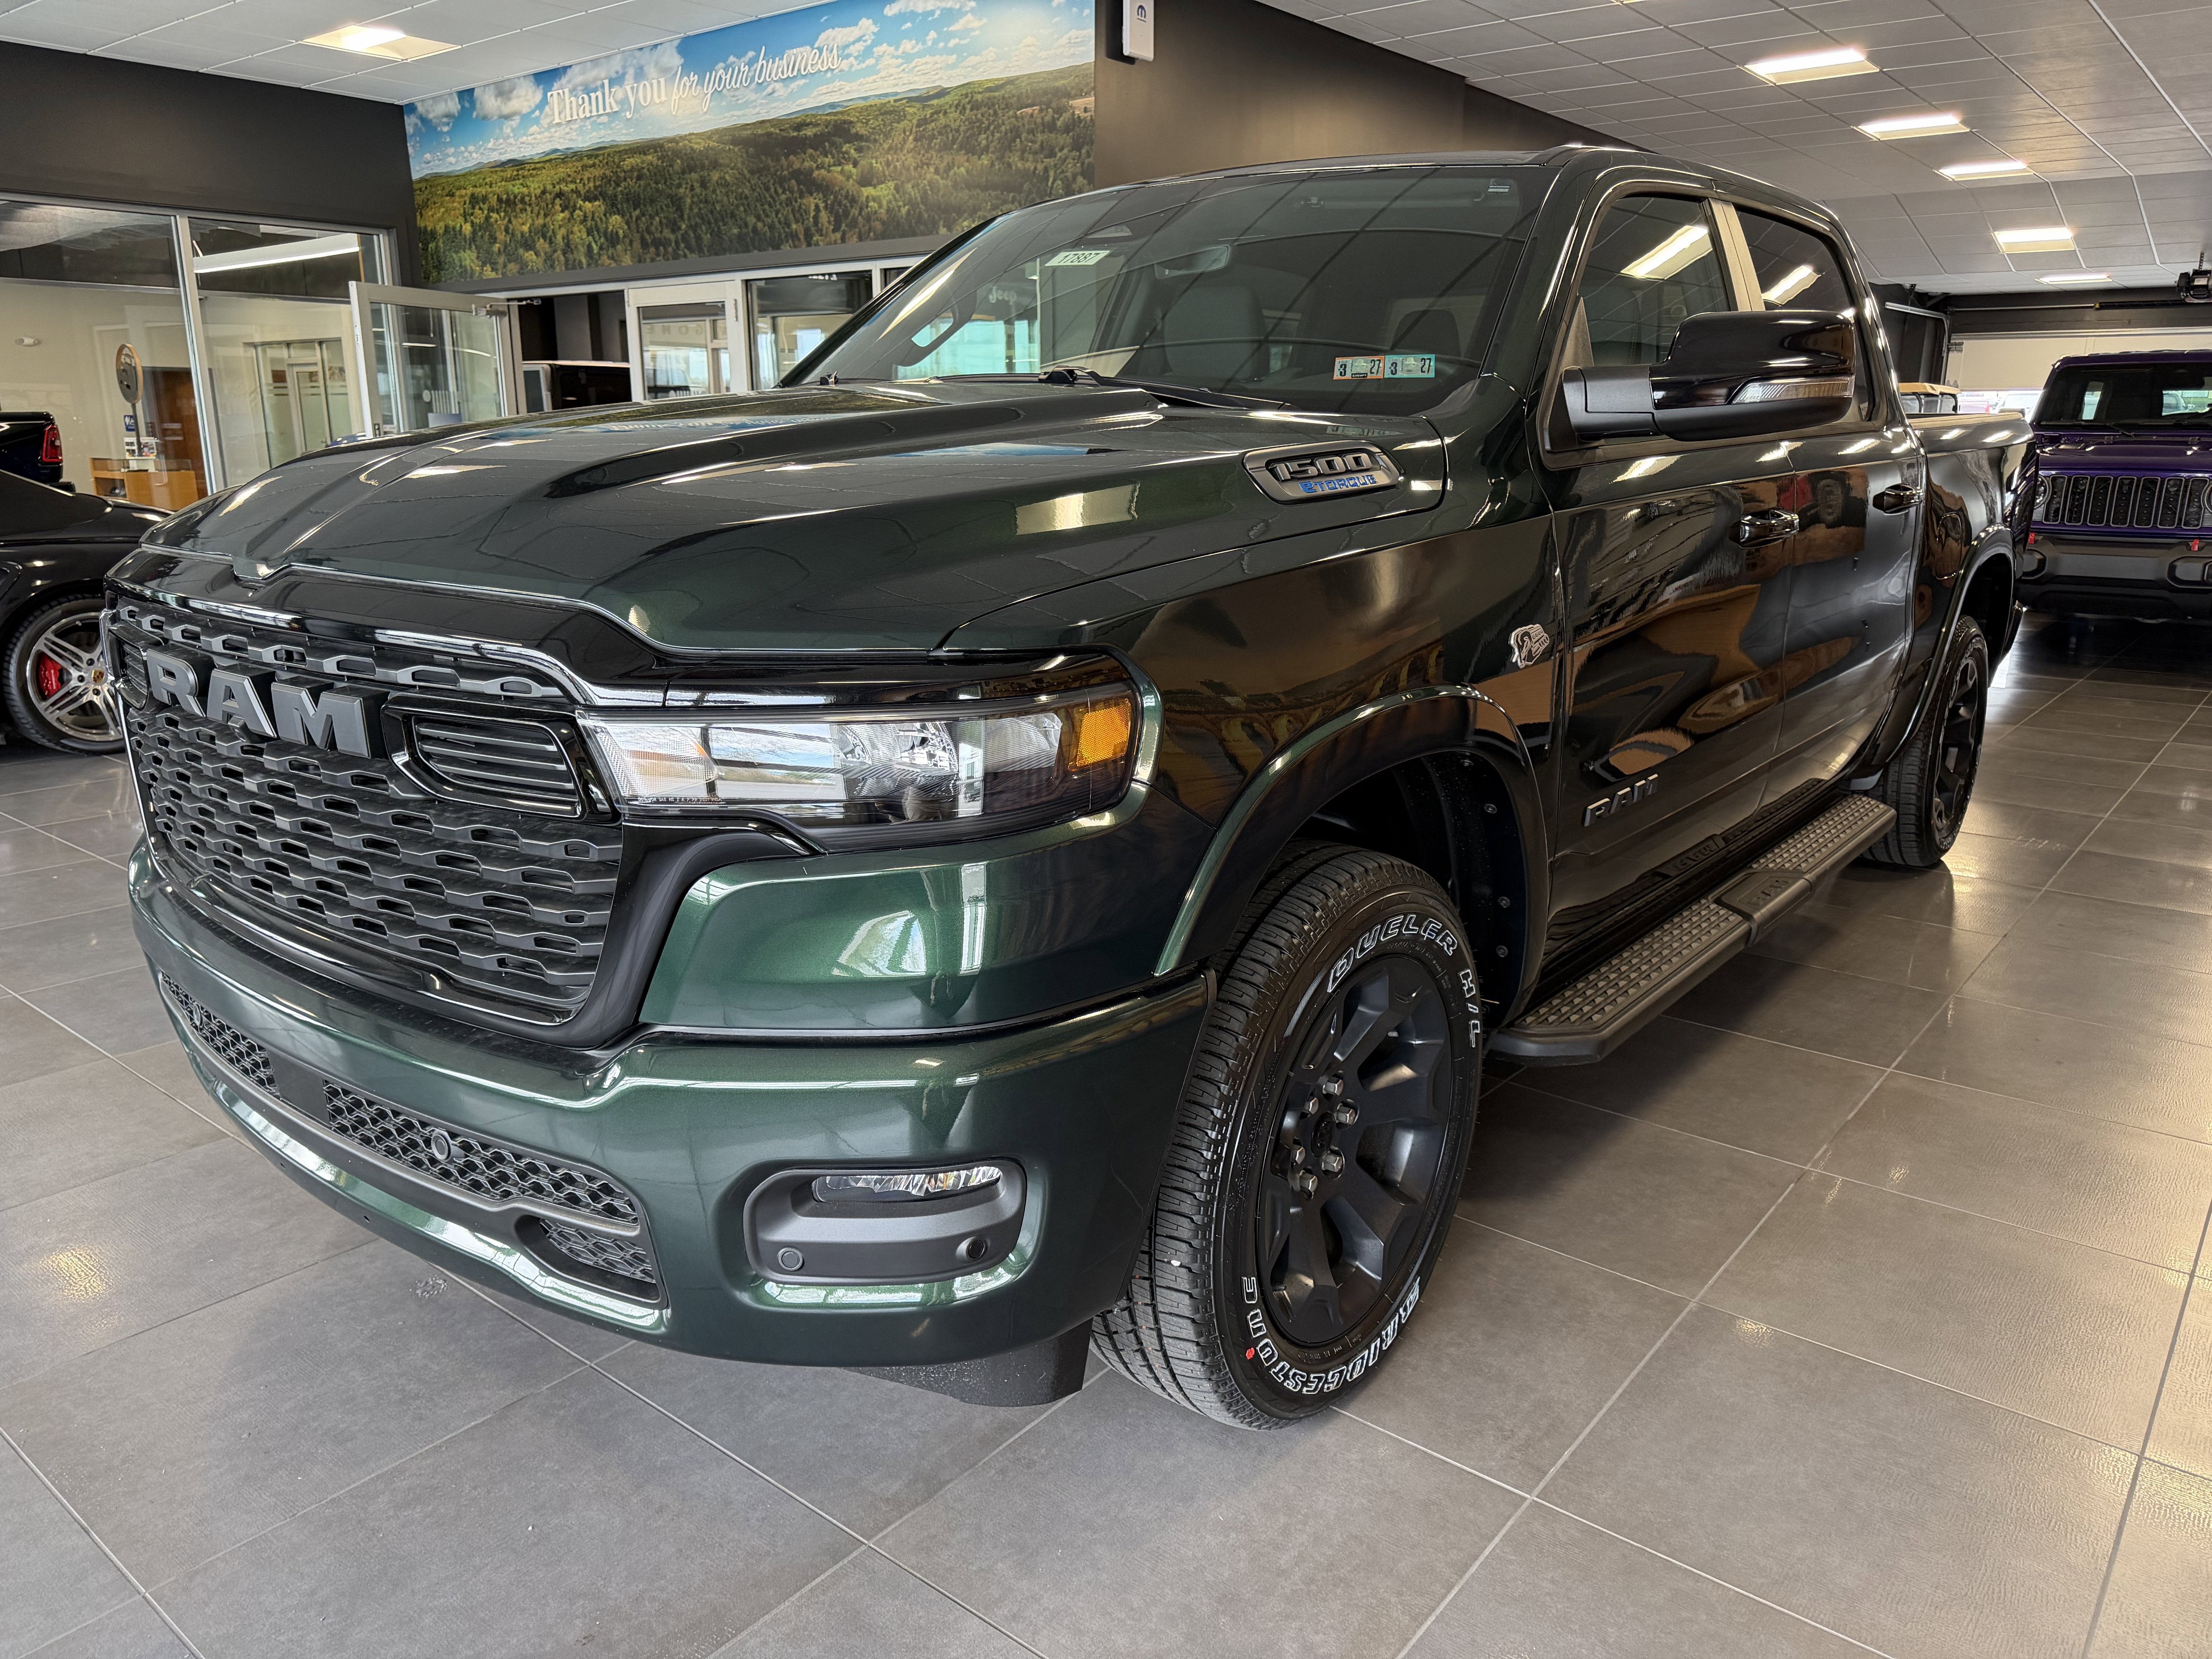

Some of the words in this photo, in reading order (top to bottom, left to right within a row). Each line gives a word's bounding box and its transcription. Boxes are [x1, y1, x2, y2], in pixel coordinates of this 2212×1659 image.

[548, 79, 620, 124] Thank
[625, 76, 668, 119] you
[671, 66, 700, 115] for
[703, 64, 750, 112] your
[755, 42, 842, 84] business
[1058, 252, 1101, 264] 17887
[989, 286, 1017, 305] Jeep
[1370, 359, 1381, 376] 27
[1390, 362, 1398, 375] 3
[1420, 357, 1432, 374] 27
[1268, 453, 1373, 483] 1500
[146, 648, 371, 759] RAM
[1584, 773, 1658, 827] RAM
[1327, 914, 1458, 993] DUELER
[1241, 1276, 1420, 1395] BRIDGESTONE
